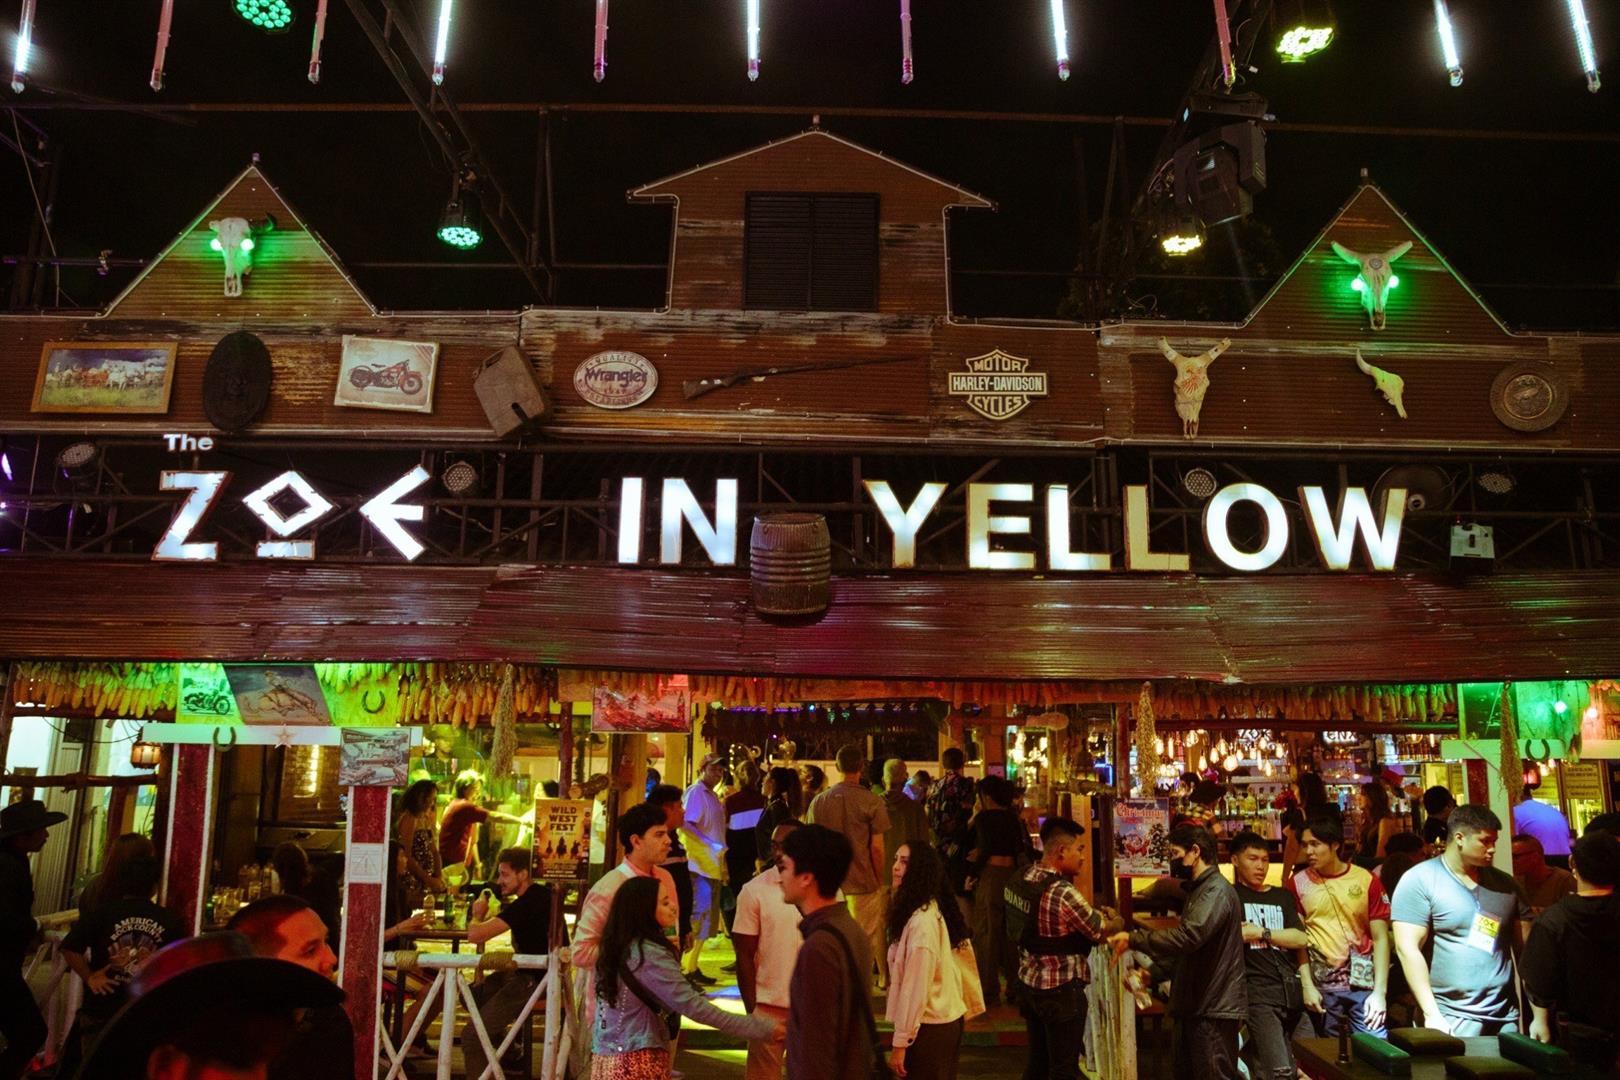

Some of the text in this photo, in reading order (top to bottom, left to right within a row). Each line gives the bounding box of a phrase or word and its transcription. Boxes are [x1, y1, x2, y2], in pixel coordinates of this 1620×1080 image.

[974, 354, 1021, 371] MOTOR
[585, 367, 648, 388] Wrangler
[953, 376, 1042, 391] HARLEY-DAVIDSON
[974, 396, 1022, 416] CYCLES
[163, 433, 214, 451] The
[154, 465, 1408, 572] ZOE IN YELLOW
[551, 806, 577, 814] WILD
[1004, 888, 1030, 913] GUARD
[115, 917, 165, 934] AMERICAN
